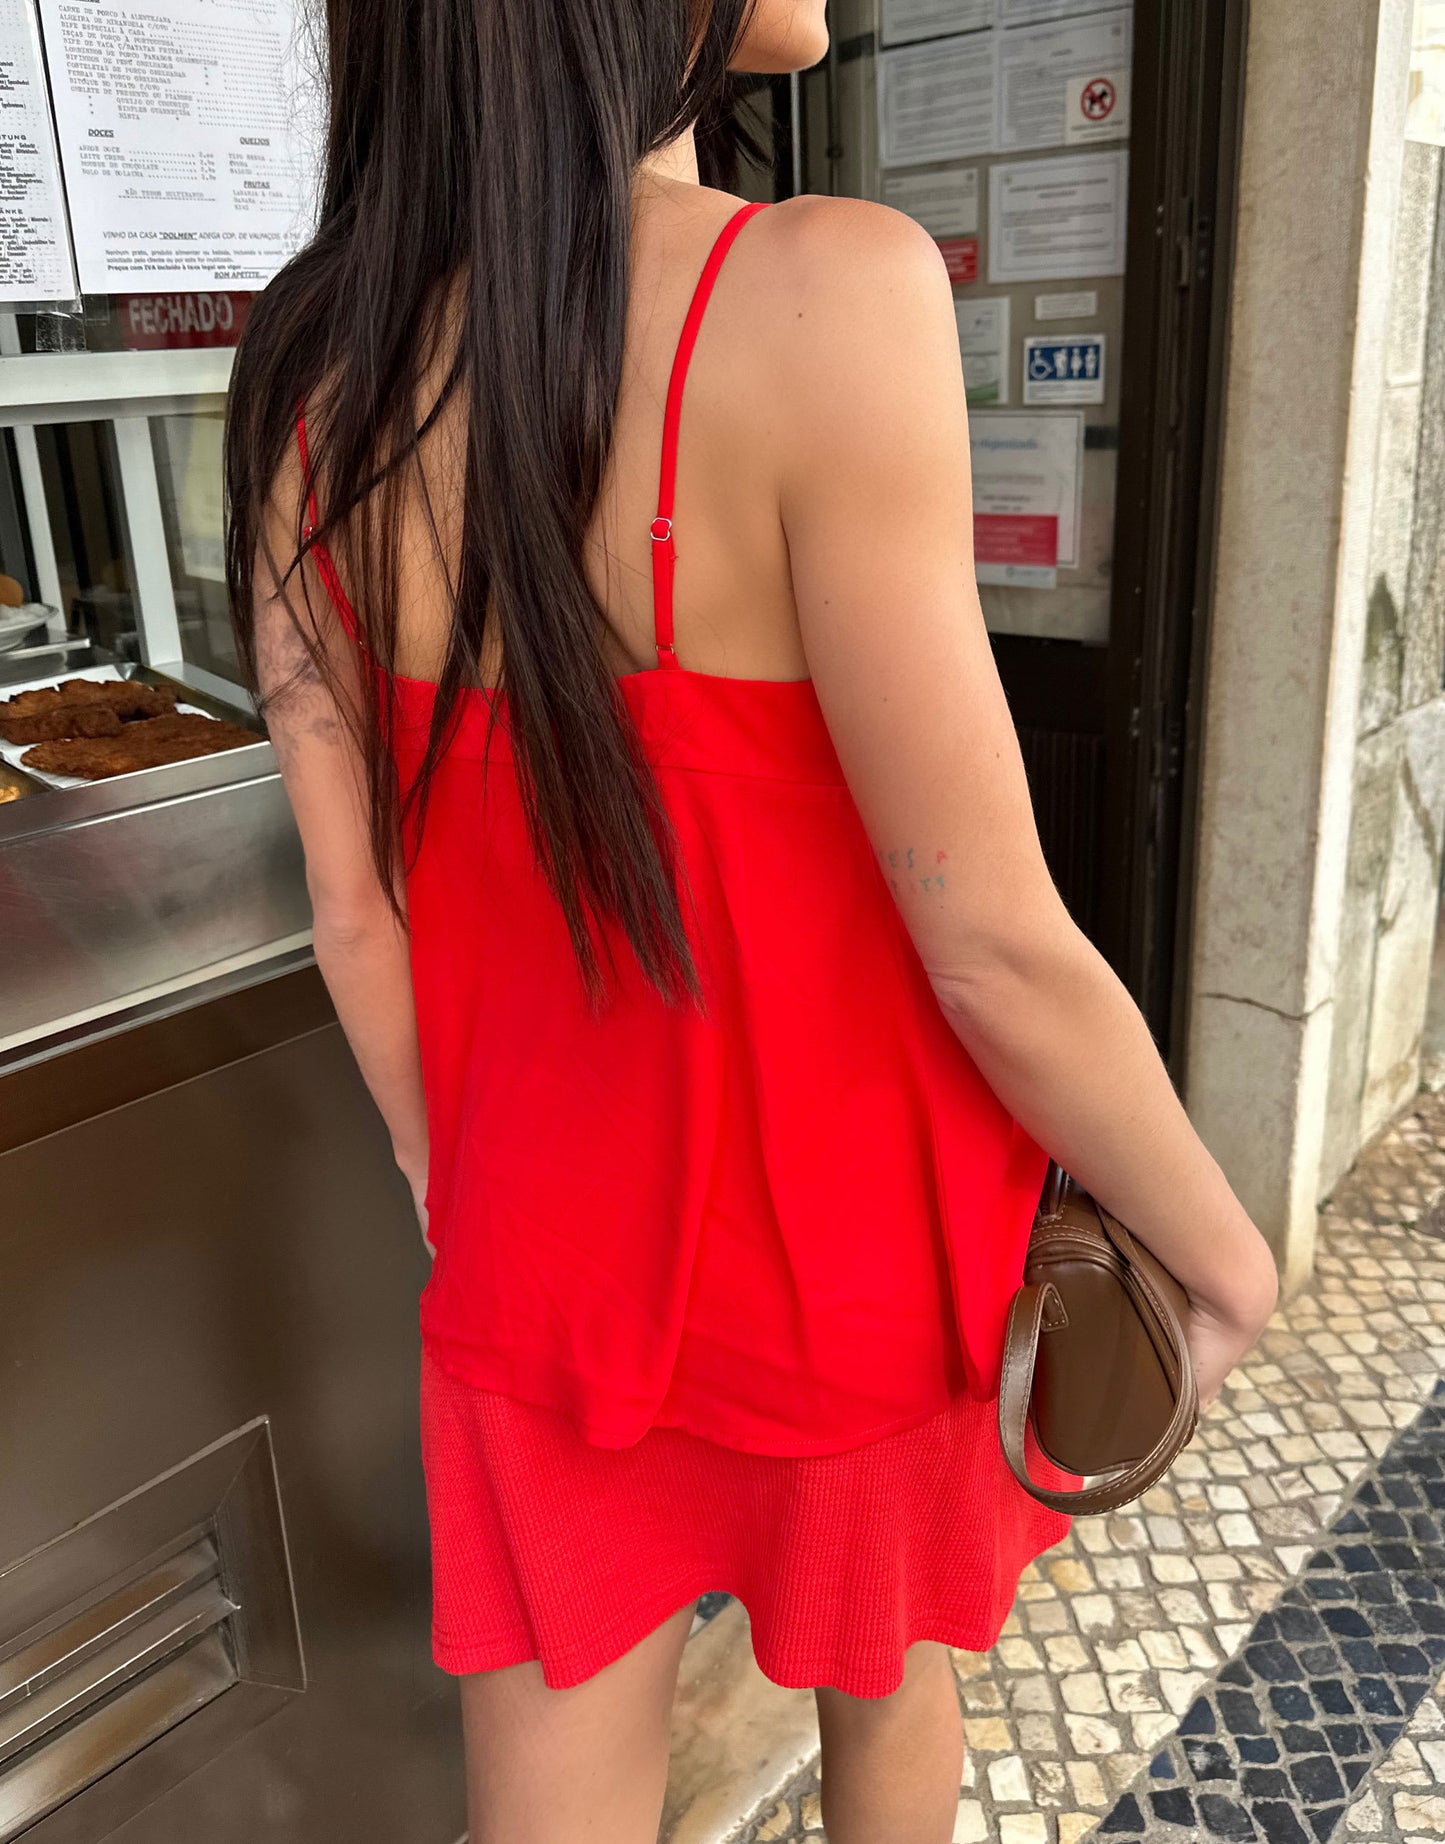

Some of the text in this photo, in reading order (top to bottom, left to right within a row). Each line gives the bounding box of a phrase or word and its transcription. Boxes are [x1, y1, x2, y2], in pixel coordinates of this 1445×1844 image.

[97, 9, 118, 17] PORCO
[88, 128, 114, 138] DOCES
[239, 137, 270, 146] QUEIJOS
[243, 180, 271, 189] FRUTAS
[103, 231, 126, 239] VINHO
[199, 232, 220, 240] ADEGA
[128, 293, 233, 334] FECHADO
